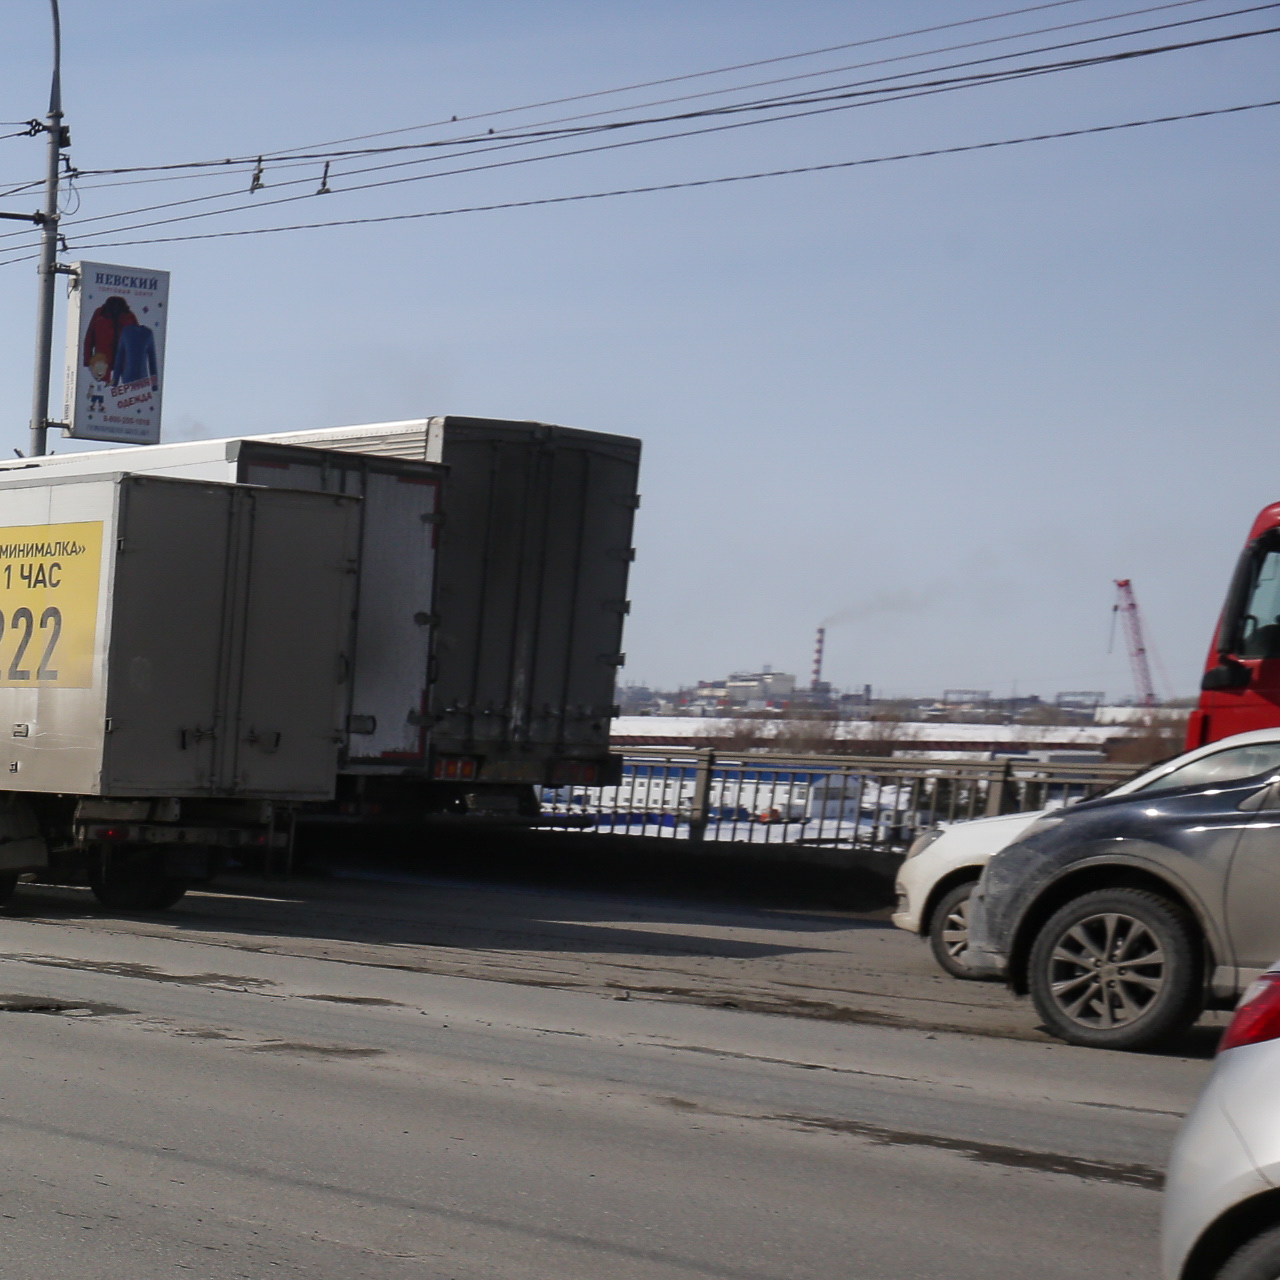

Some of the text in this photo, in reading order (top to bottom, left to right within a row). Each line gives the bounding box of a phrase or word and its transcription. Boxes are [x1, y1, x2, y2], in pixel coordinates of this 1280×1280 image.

[95, 272, 158, 290] НЕВСКИЙ
[4, 562, 62, 589] 1 ЧАС
